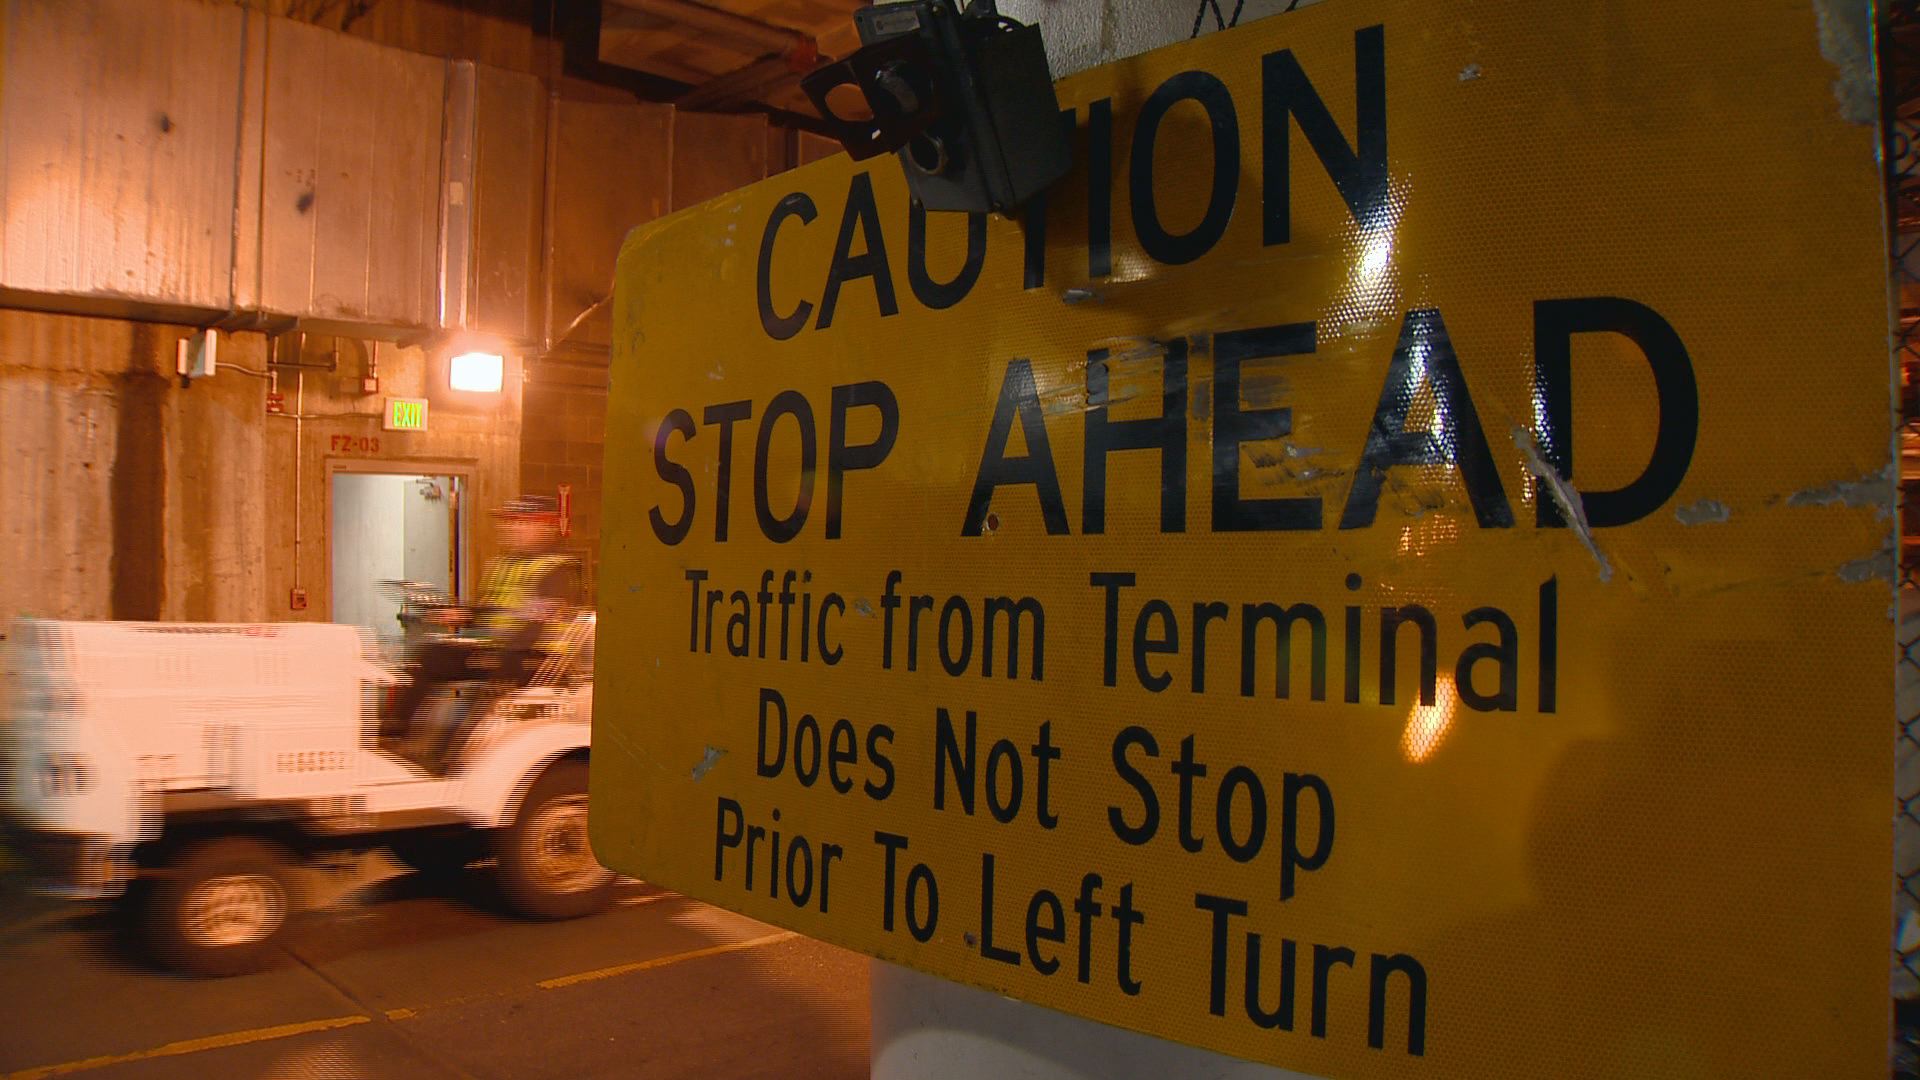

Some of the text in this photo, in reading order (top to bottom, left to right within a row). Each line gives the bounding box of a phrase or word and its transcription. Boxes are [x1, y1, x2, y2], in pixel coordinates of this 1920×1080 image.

[331, 435, 380, 453] FZ-03
[393, 400, 422, 428] EXIT
[648, 297, 1700, 546] STOP AHEAD
[685, 569, 1558, 714] Traffic from Terminal
[756, 687, 1336, 902] Does Not Stop
[714, 796, 1428, 1057] Prior To Left Turn
